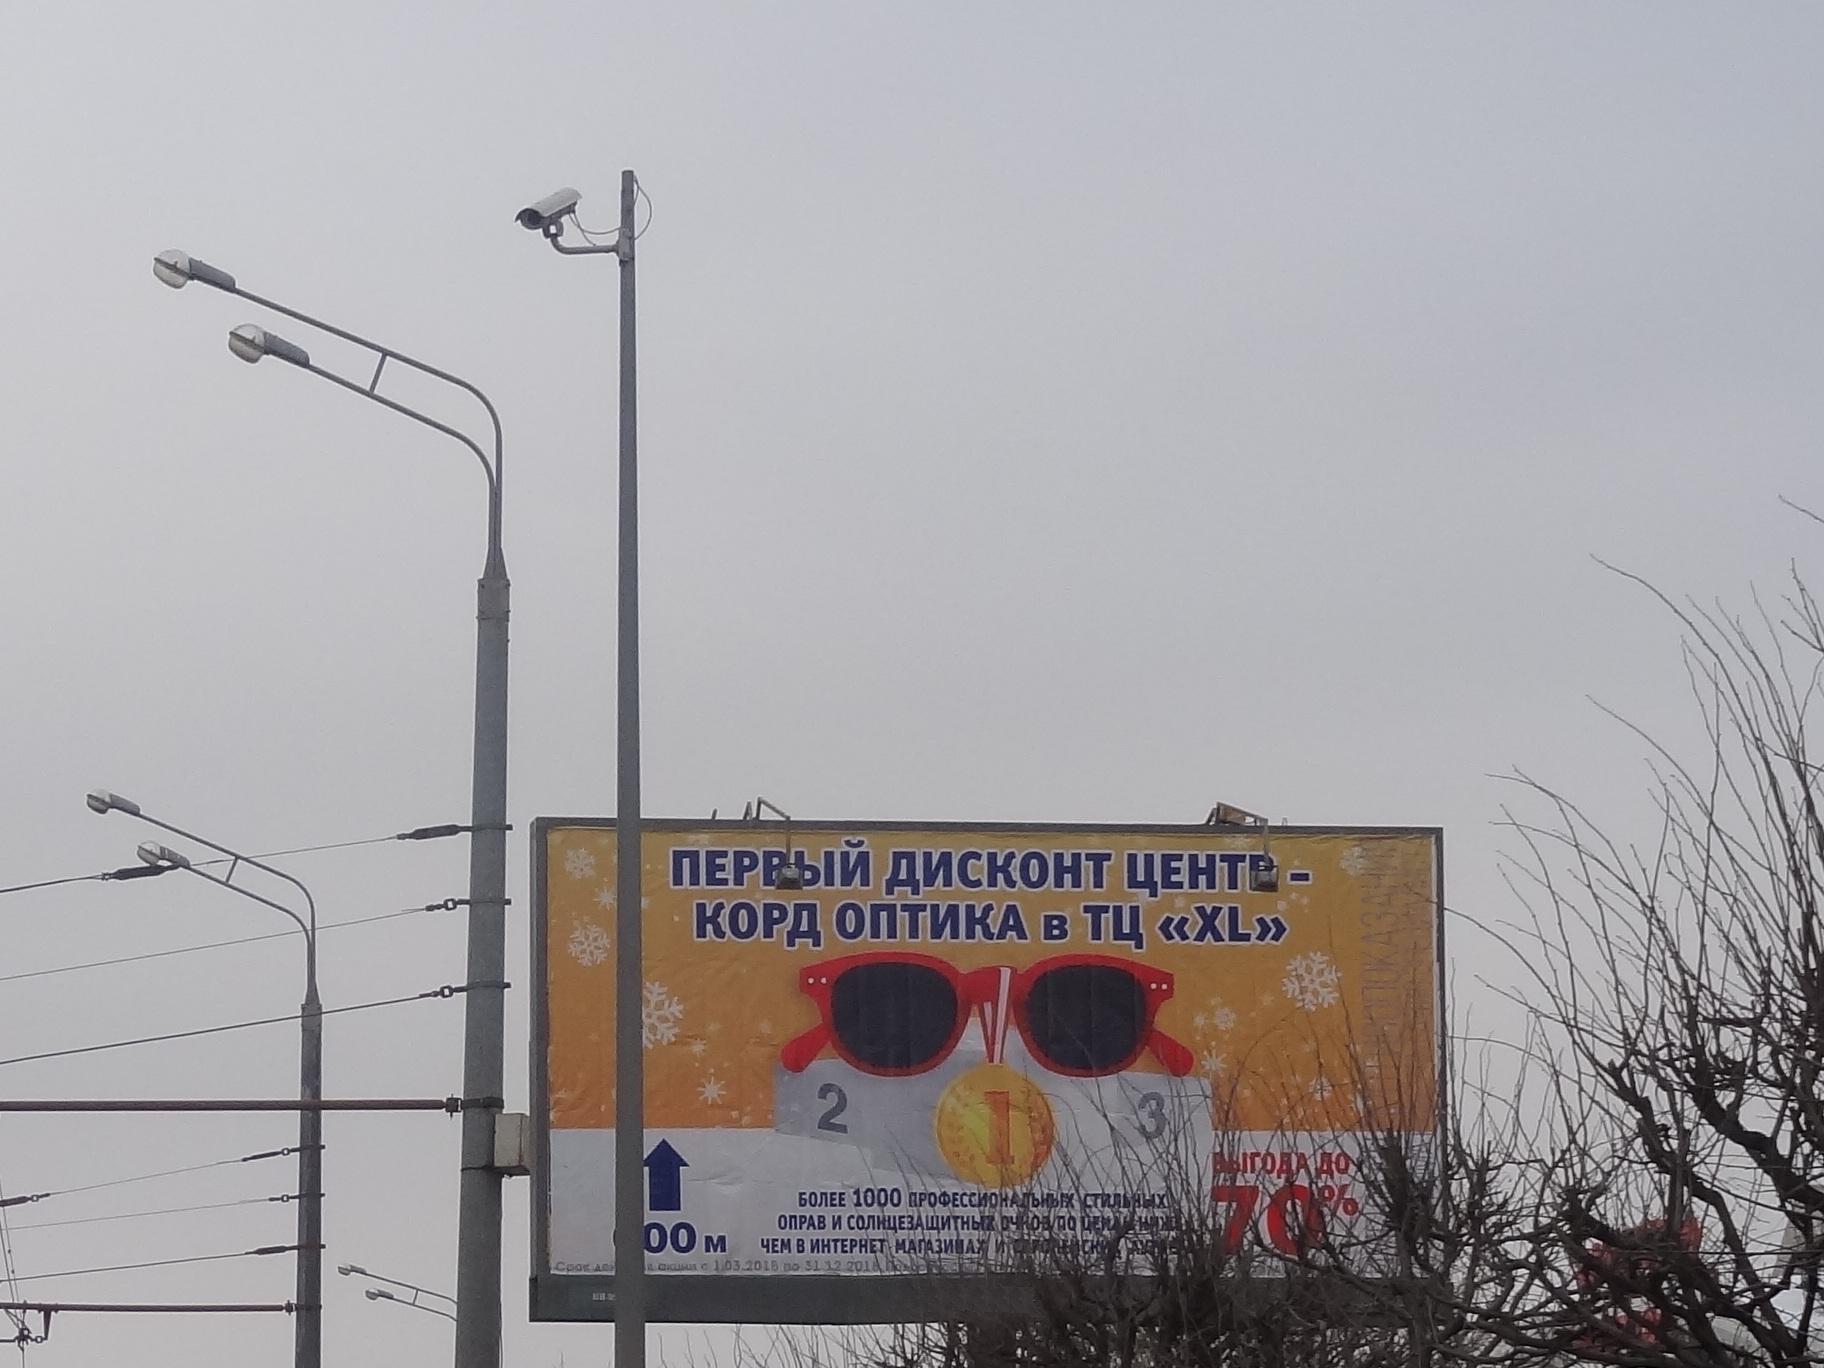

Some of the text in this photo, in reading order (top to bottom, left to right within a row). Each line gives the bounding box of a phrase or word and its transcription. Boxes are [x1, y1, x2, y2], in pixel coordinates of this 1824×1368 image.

[671, 838, 872, 889] ПЕРВЫЙ
[884, 849, 1113, 897] ДИСКОНТ
[695, 901, 822, 948] КОРД
[835, 902, 1028, 942] ОПТИКА
[1082, 903, 1145, 950] ТЦ
[816, 1082, 849, 1134] 2
[983, 1090, 1015, 1165] 1
[1138, 1091, 1167, 1139] 3
[1212, 1151, 1350, 1179] ВЫГОДА ДО
[798, 1191, 846, 1208] БОЛЕЕ
[852, 1187, 903, 1208] 1000
[908, 1191, 1075, 1209] ПРОФЕССИОНАЛЬНЫХ
[613, 1221, 697, 1254] 00
[777, 1214, 827, 1231] ОПРАВ
[831, 1214, 842, 1231] И
[846, 1214, 995, 1234] СОЛНЦЕЗАЩИТНЫХ
[760, 1237, 792, 1254] ЧЕМ
[795, 1237, 806, 1254] В
